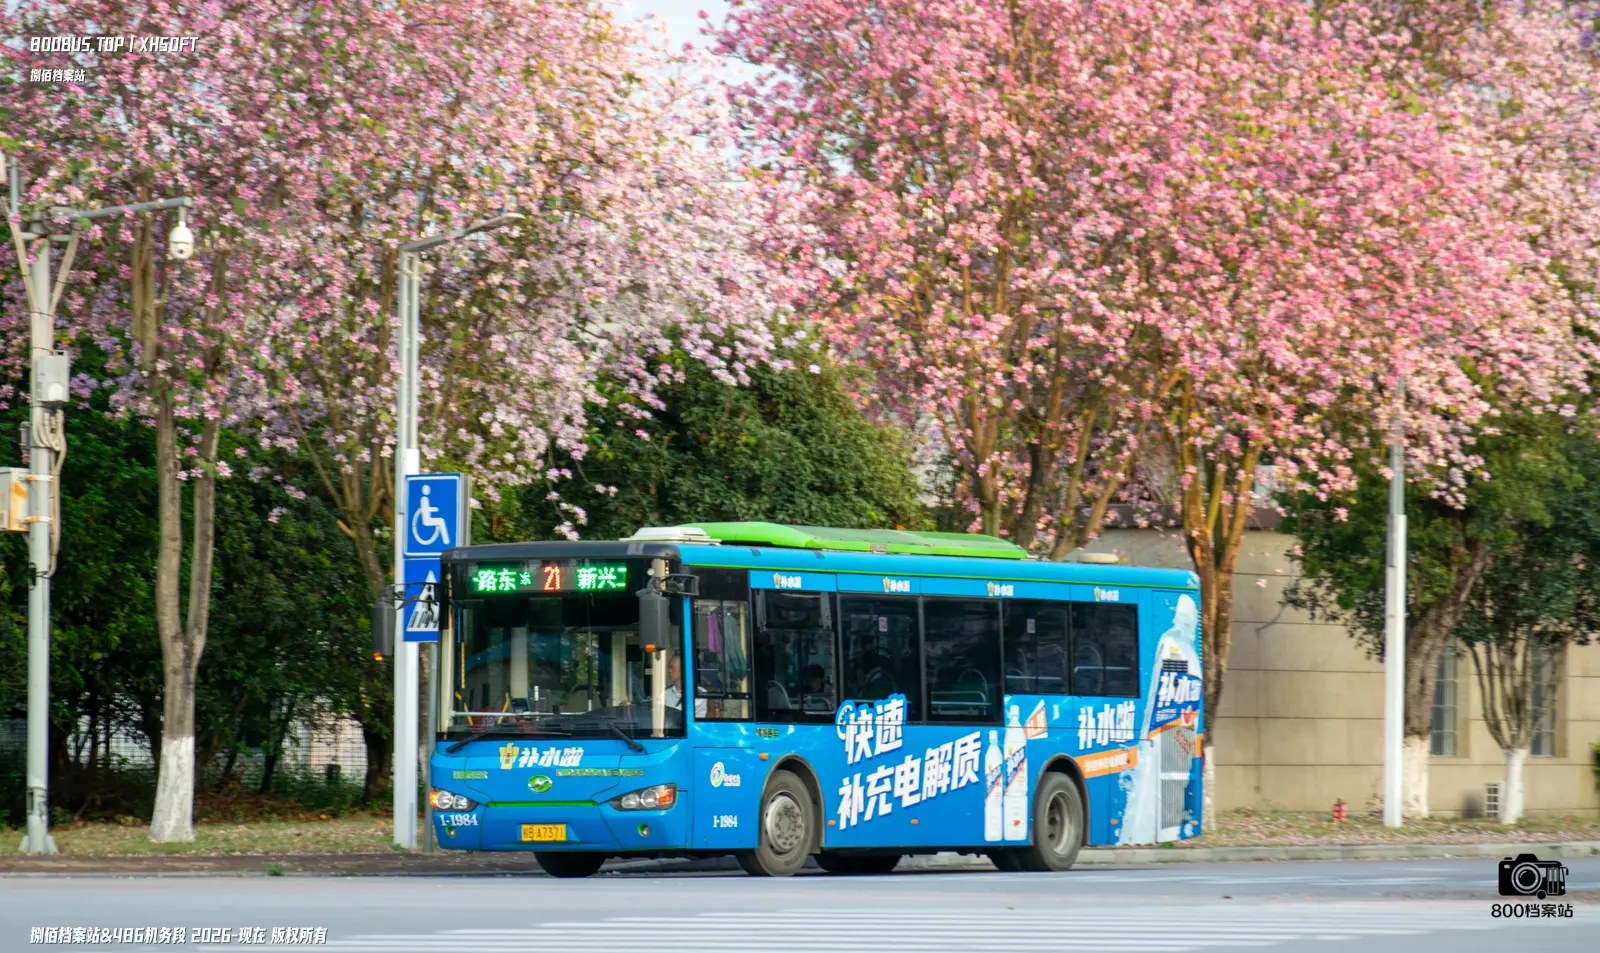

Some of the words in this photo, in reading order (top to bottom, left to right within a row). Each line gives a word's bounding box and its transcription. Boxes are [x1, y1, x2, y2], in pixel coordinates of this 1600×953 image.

[472, 568, 517, 591] 路东
[543, 566, 561, 590] 21
[844, 698, 904, 765] 快速
[837, 731, 982, 830] 补充电解质
[439, 813, 479, 827] 1-1984
[713, 815, 738, 828] 1-1984
